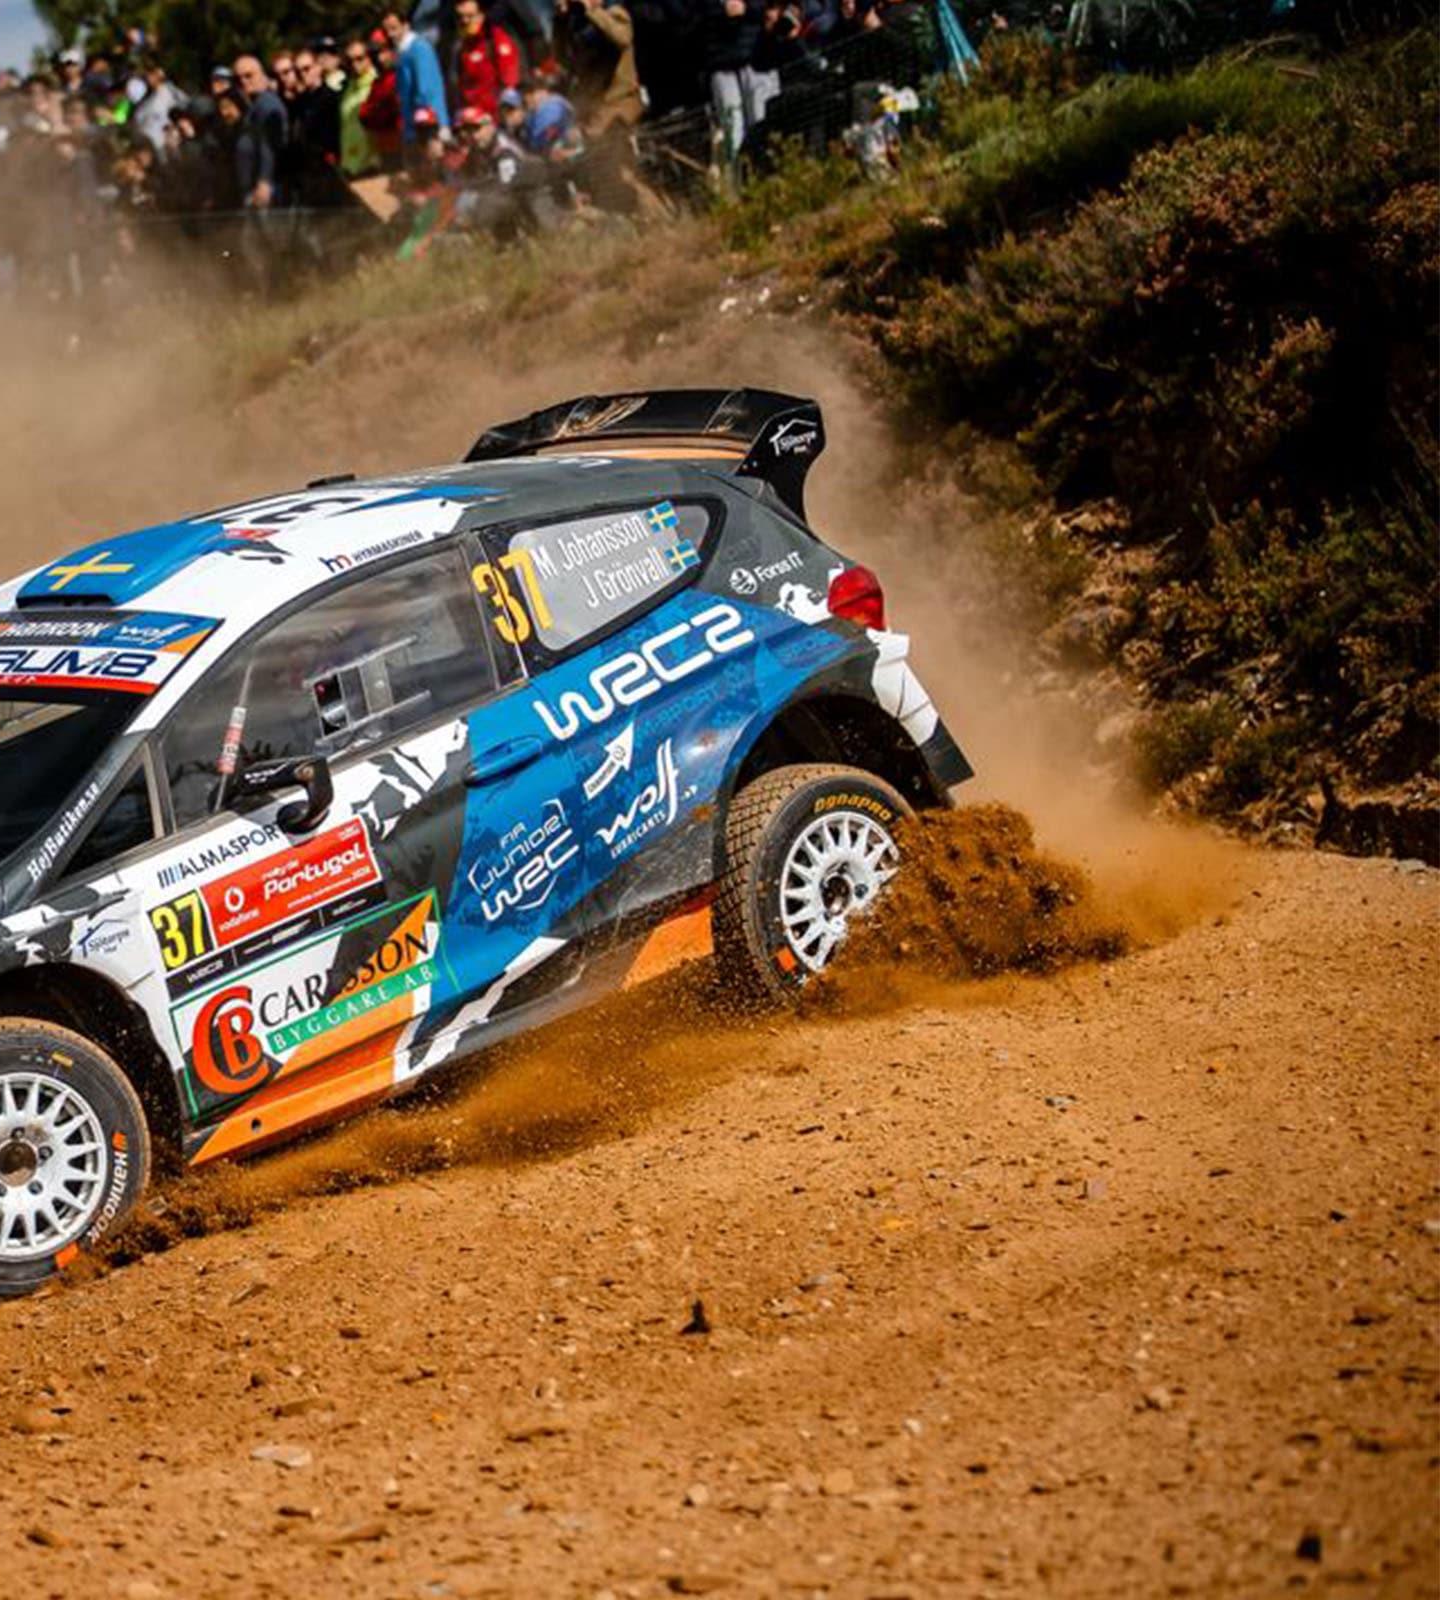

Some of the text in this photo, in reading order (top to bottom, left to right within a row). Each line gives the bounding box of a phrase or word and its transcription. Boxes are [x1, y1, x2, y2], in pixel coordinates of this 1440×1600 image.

[530, 513, 649, 580] M Johansson
[582, 546, 671, 608] J Grönvall
[787, 550, 805, 570] IT
[471, 547, 555, 645] 37
[533, 603, 755, 741] WRC2
[179, 820, 282, 879] ALMASPOR
[479, 813, 562, 890] JUNIOR
[498, 821, 528, 850] FIA
[610, 809, 668, 861] LUBRICANTS
[264, 842, 366, 901] Portugal
[480, 828, 580, 922] WRC
[151, 891, 209, 969] 37
[259, 930, 431, 1028] CARSSON
[273, 964, 433, 1051] BYGGARE AB
